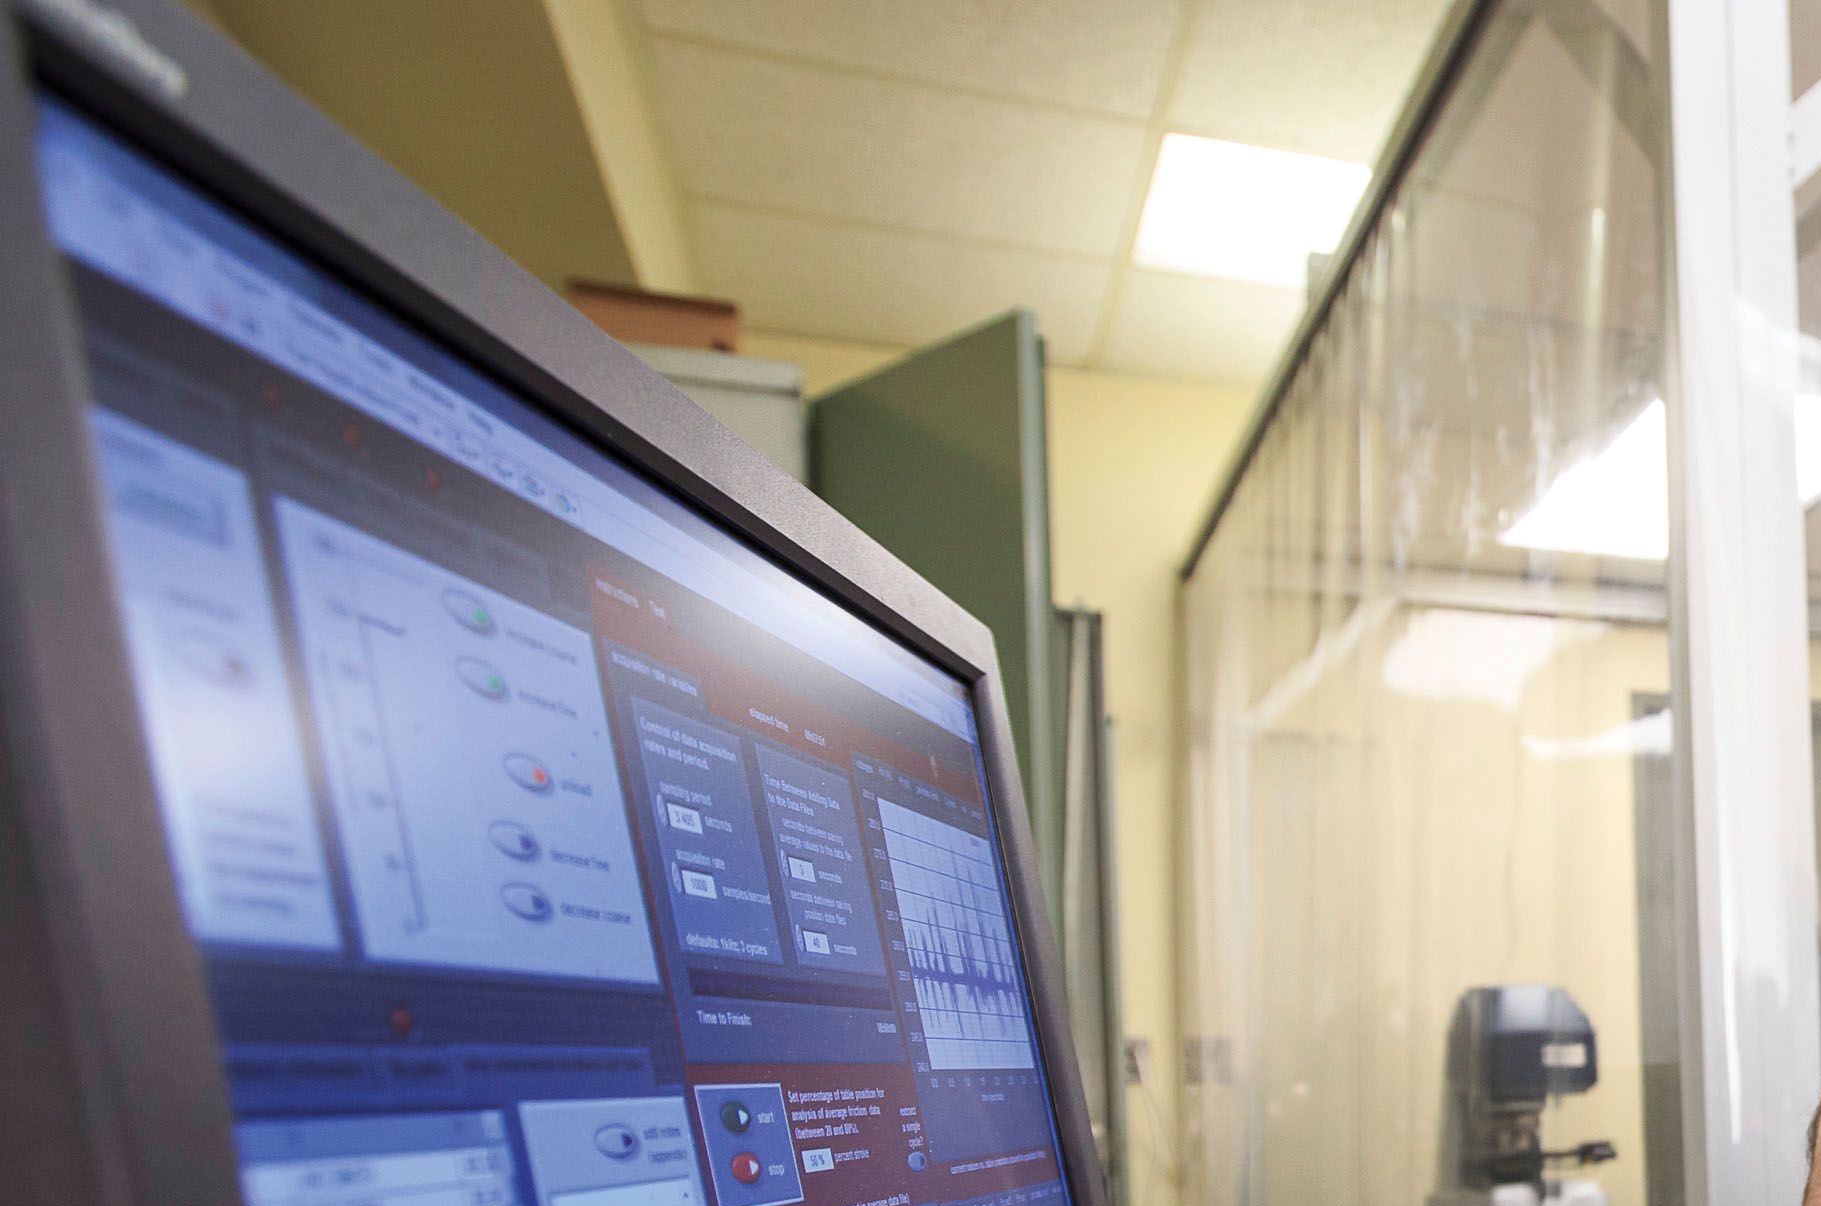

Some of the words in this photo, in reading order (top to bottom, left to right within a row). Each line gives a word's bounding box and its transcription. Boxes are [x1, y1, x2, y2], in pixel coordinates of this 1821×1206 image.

[639, 716, 672, 739] Control
[680, 733, 698, 749] data
[667, 747, 682, 762] and
[696, 1009, 717, 1025] Time
[717, 1012, 727, 1025] to
[787, 1090, 799, 1103] Set
[799, 1090, 834, 1104] percentage
[839, 1089, 855, 1100] table
[854, 1088, 877, 1102] position
[876, 1087, 885, 1098] for
[757, 1111, 775, 1124] start
[791, 1108, 818, 1122] analysis
[824, 1108, 848, 1119] average
[847, 1105, 868, 1116] friction
[868, 1104, 881, 1115] data
[832, 1124, 845, 1135] and
[834, 1150, 855, 1162] percent
[768, 1164, 785, 1176] stop
[887, 1196, 900, 1206] data
